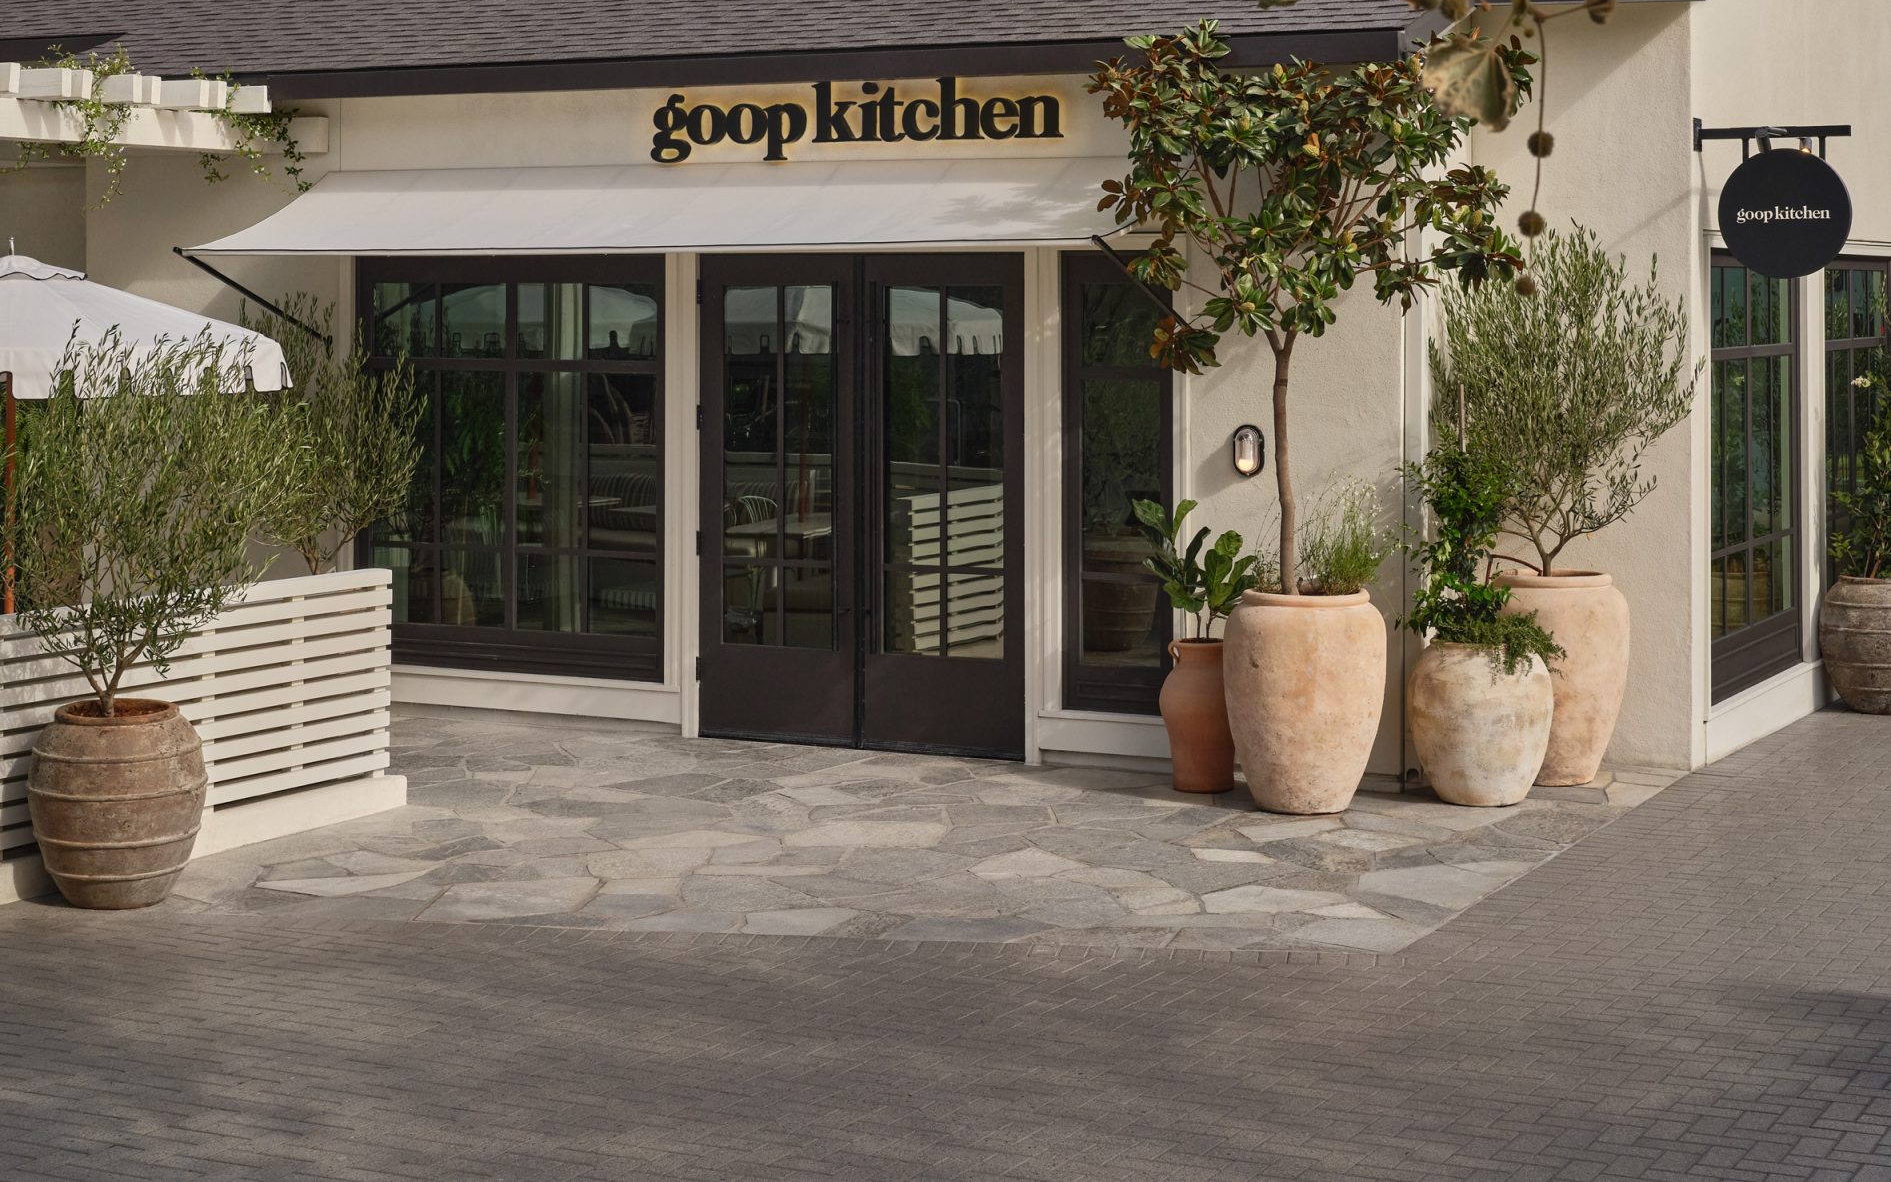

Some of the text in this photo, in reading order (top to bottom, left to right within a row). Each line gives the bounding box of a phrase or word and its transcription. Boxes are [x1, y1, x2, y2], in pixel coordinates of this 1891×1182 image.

[650, 76, 1064, 163] goop kitchen
[1736, 205, 1830, 224] goop kitchen
